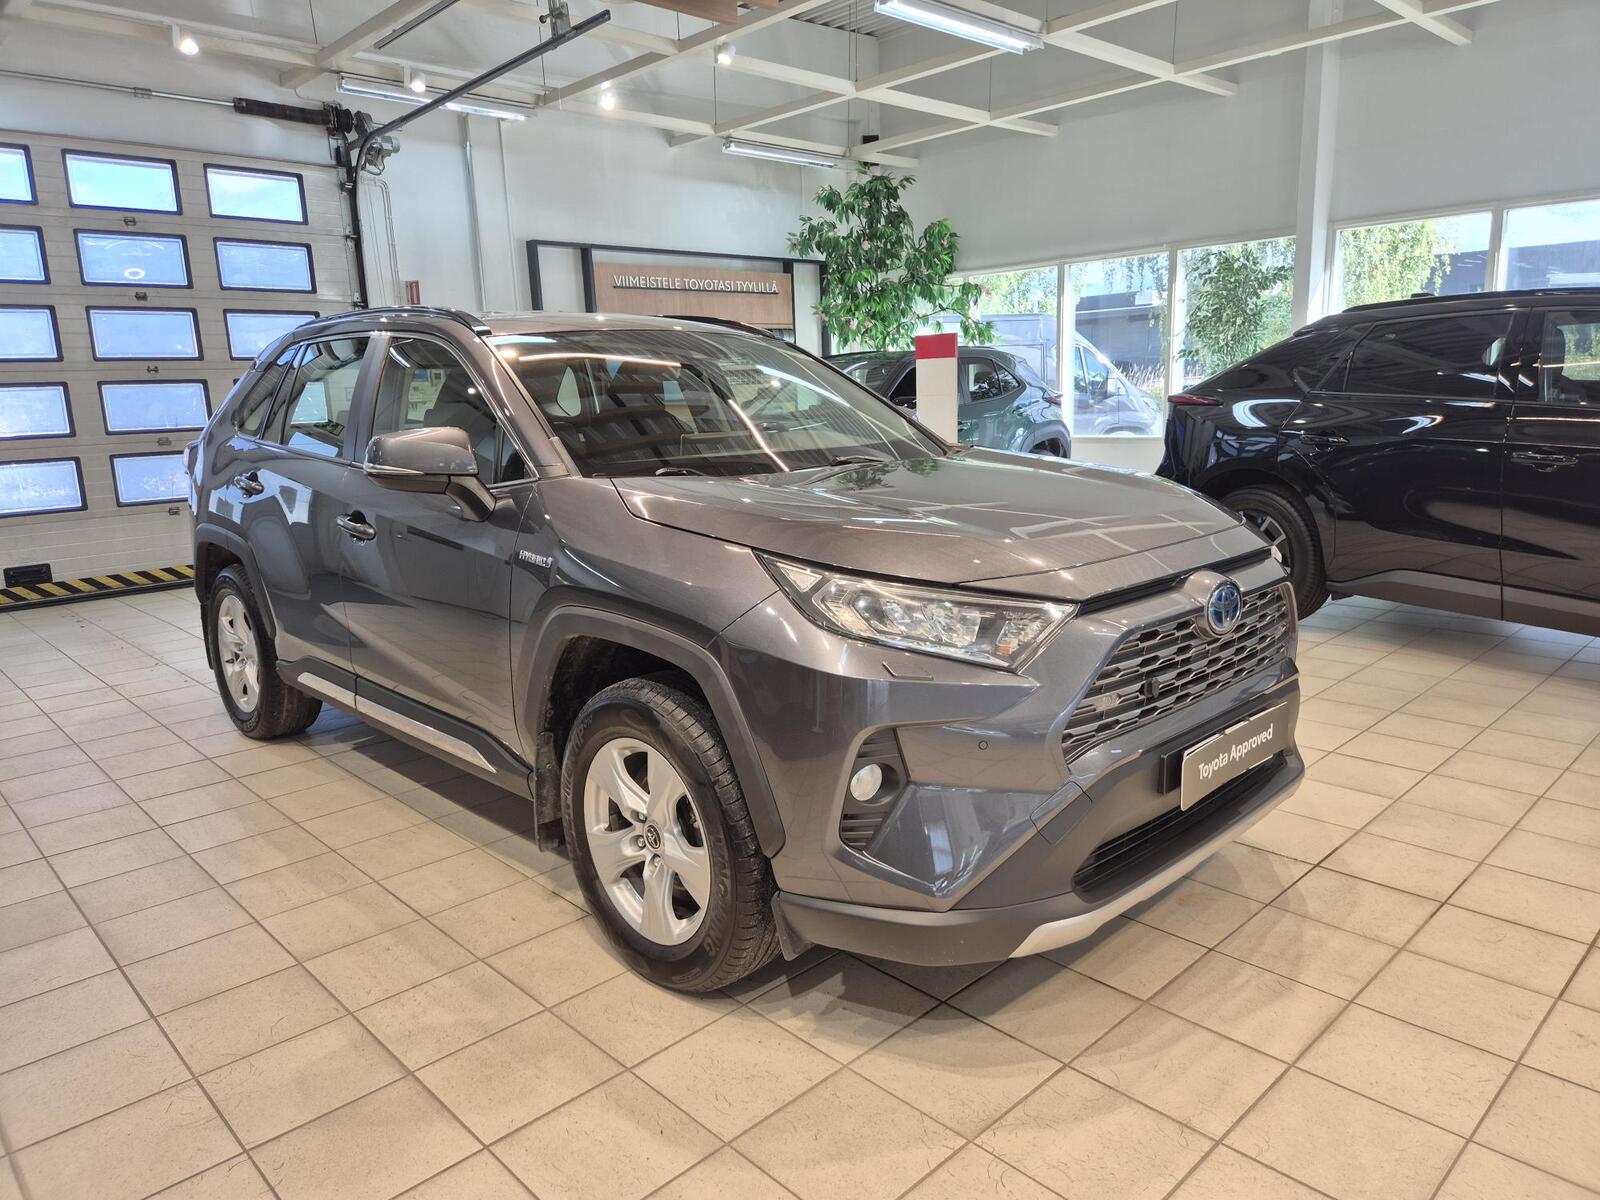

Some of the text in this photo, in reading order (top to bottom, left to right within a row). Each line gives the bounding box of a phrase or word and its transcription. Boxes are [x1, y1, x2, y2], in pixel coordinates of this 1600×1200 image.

[613, 274, 778, 293] VIIMEISTELE TOYOTASI TYYLILLÄ
[1198, 723, 1274, 780] Toyota Approved
